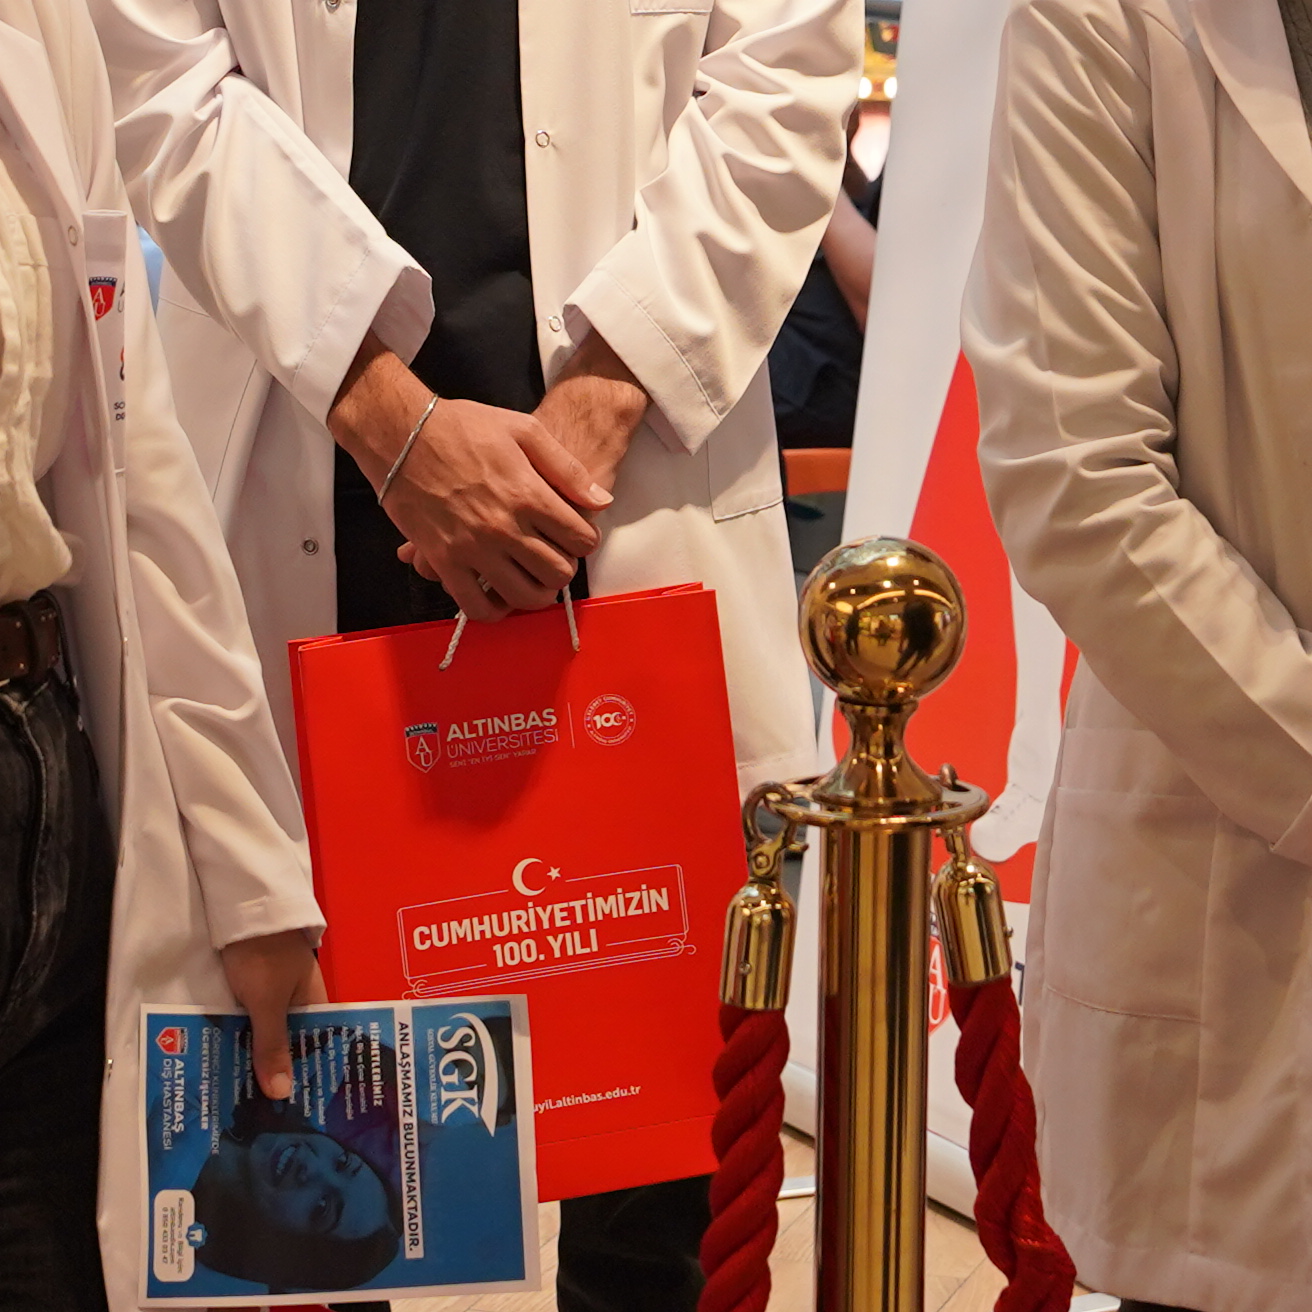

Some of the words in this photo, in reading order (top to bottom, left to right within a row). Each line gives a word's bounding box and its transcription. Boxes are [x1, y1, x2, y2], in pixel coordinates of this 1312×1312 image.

[412, 883, 670, 951] CUMHURİYETİMİZİN
[492, 938, 546, 968] 100.
[546, 927, 599, 960] YILI
[171, 1058, 185, 1132] ALTINBAŞ
[369, 1021, 385, 1107] HİZMETLERİMİZ
[398, 1022, 413, 1118] ANLAŞMAMIZ
[437, 1025, 479, 1124] SGK
[162, 1081, 173, 1150] HASTANESİ
[403, 1123, 419, 1251] BULUNMAKTADIR.
